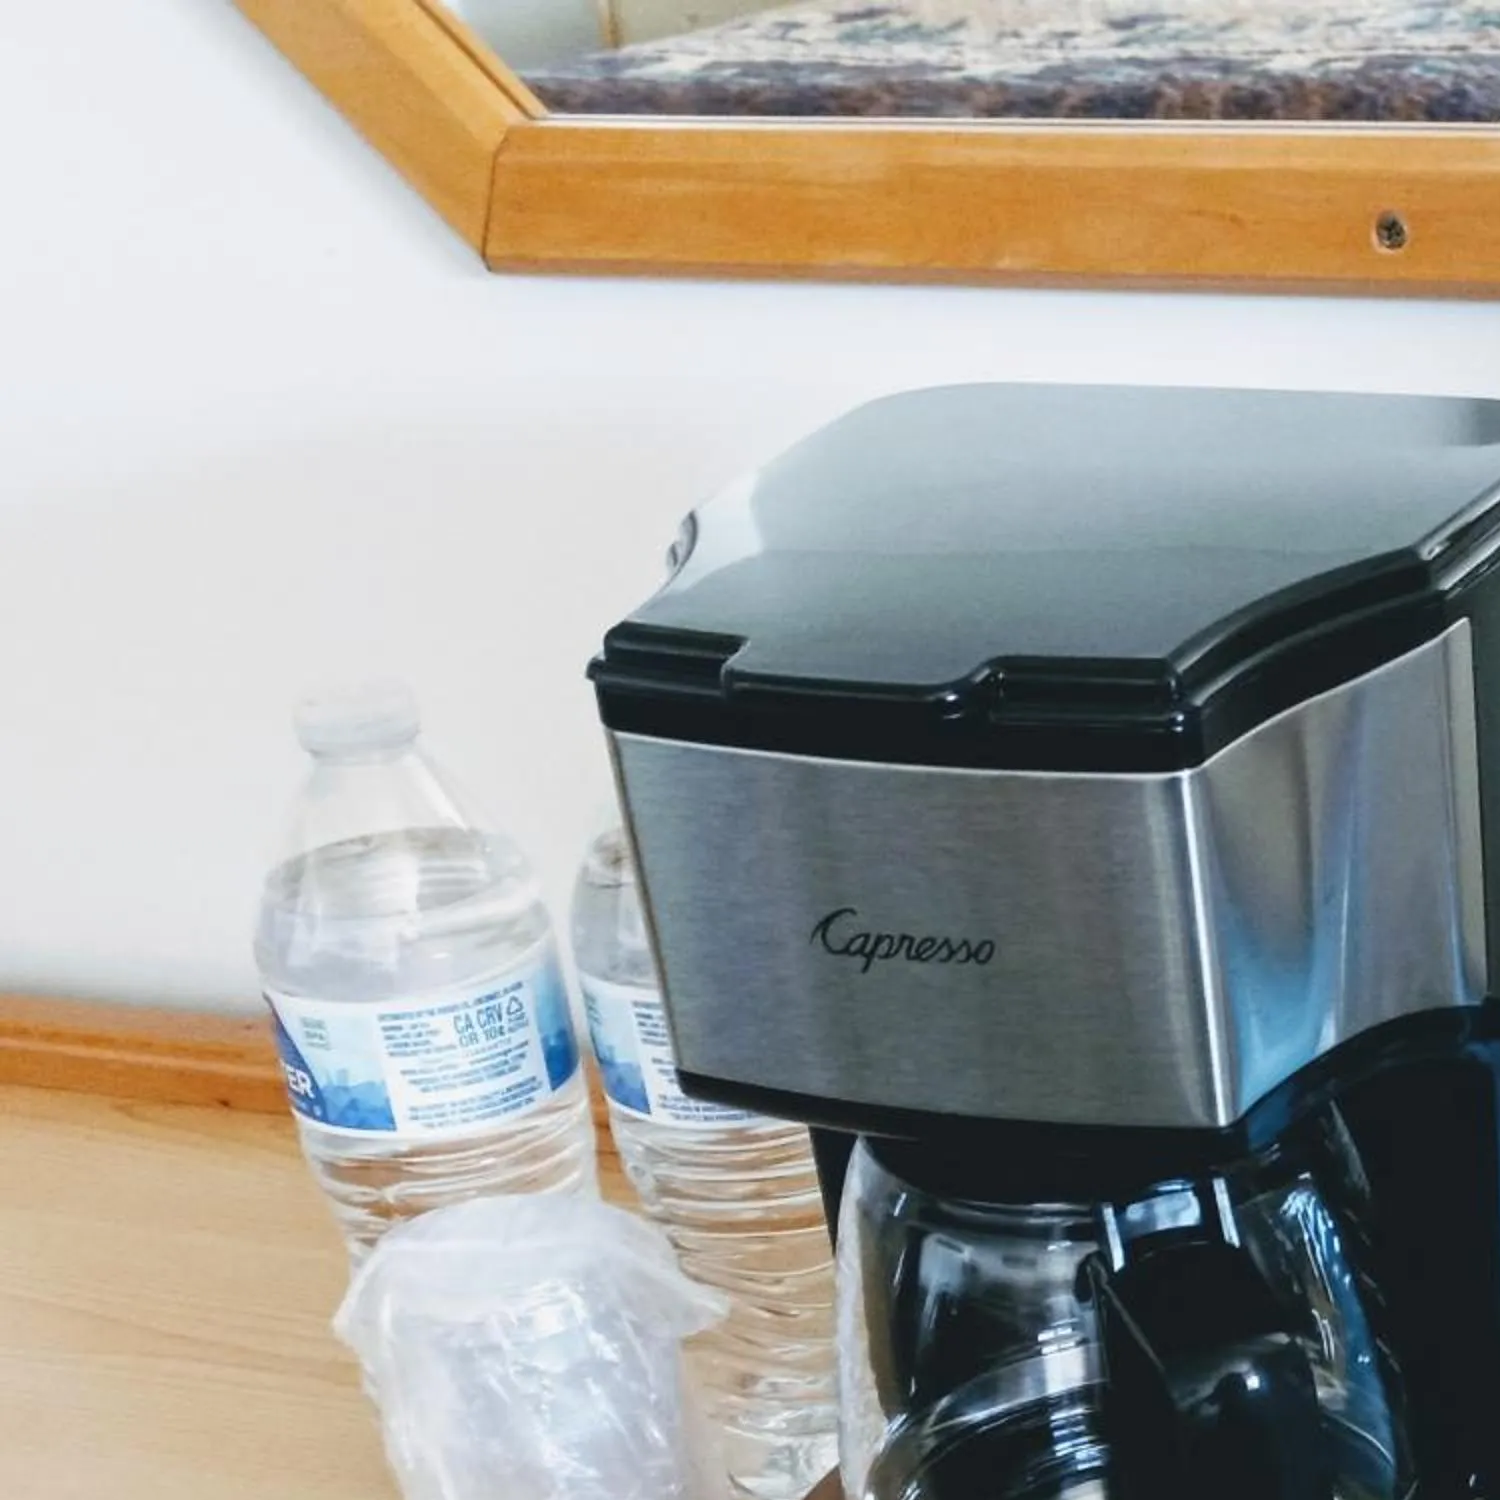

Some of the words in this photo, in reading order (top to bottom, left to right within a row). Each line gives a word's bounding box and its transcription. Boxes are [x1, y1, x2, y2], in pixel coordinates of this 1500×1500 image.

[809, 907, 996, 974] Capresso
[453, 1013, 473, 1034] CA
[476, 1002, 503, 1028] CRV
